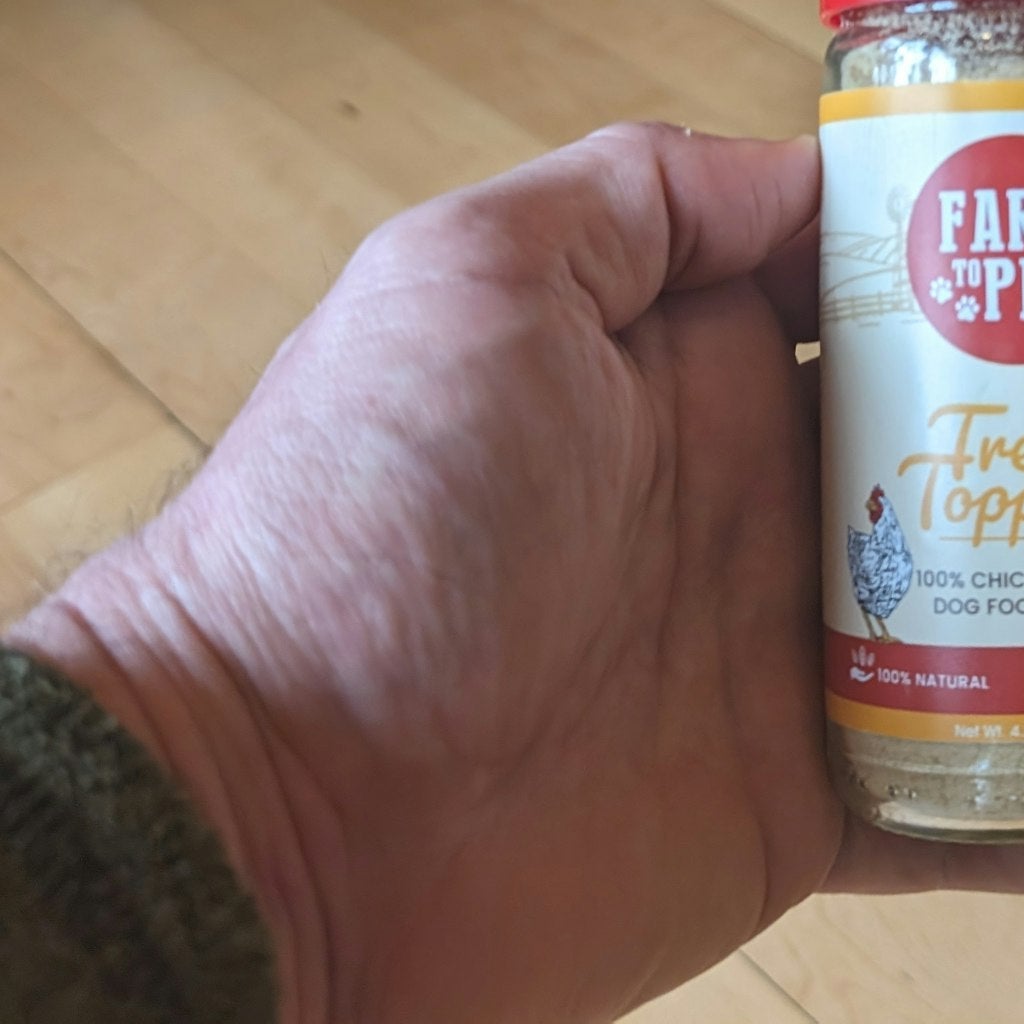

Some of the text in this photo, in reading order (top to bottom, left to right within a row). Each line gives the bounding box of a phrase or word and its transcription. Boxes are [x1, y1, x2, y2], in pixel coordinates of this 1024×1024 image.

[951, 258, 982, 288] TO
[916, 569, 965, 589] 100%
[934, 597, 980, 615] DOG
[876, 668, 990, 690] 100% NATURAL
[954, 724, 980, 737] Net
